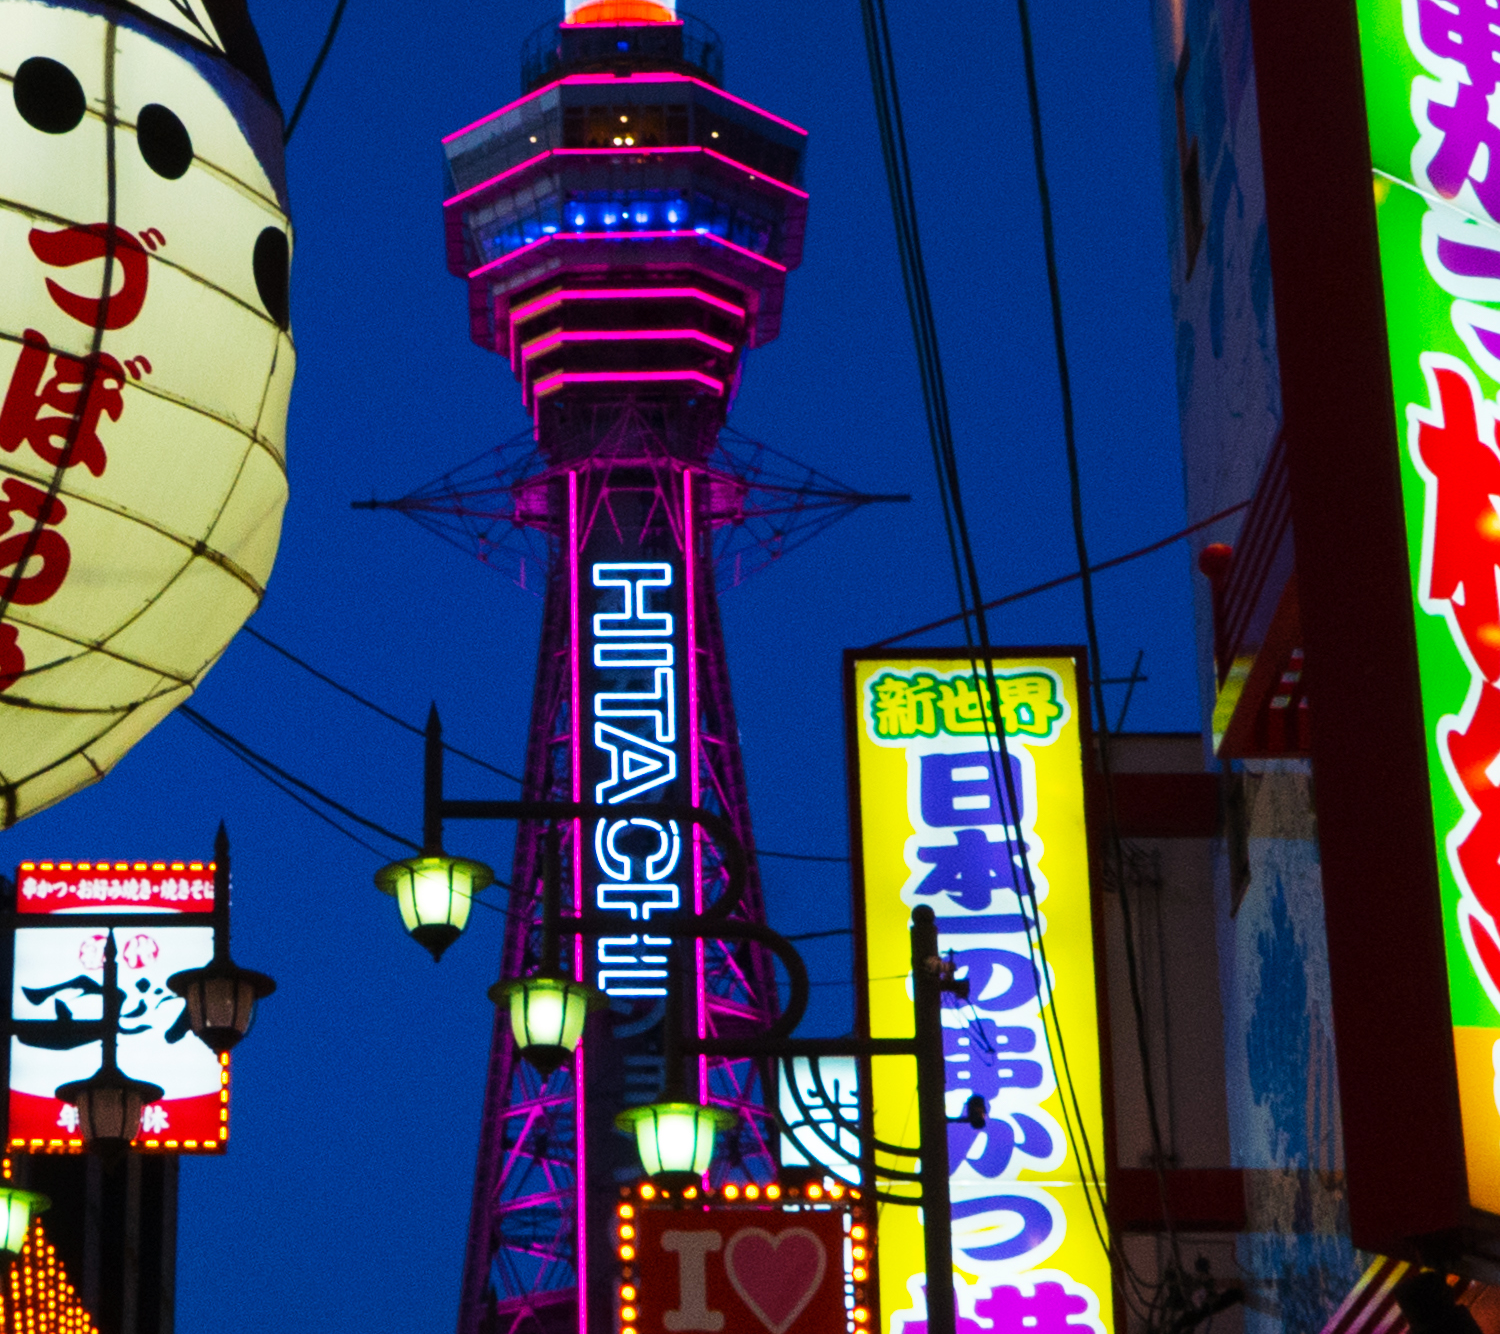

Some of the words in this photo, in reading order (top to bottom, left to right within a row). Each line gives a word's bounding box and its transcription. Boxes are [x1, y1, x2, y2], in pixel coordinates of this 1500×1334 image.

[869, 675, 1062, 743] 新世界
[592, 561, 681, 998] HITACHI
[908, 749, 1060, 1267] 日本一の串かつ
[56, 1103, 170, 1134] 年休
[660, 1228, 727, 1334] I
